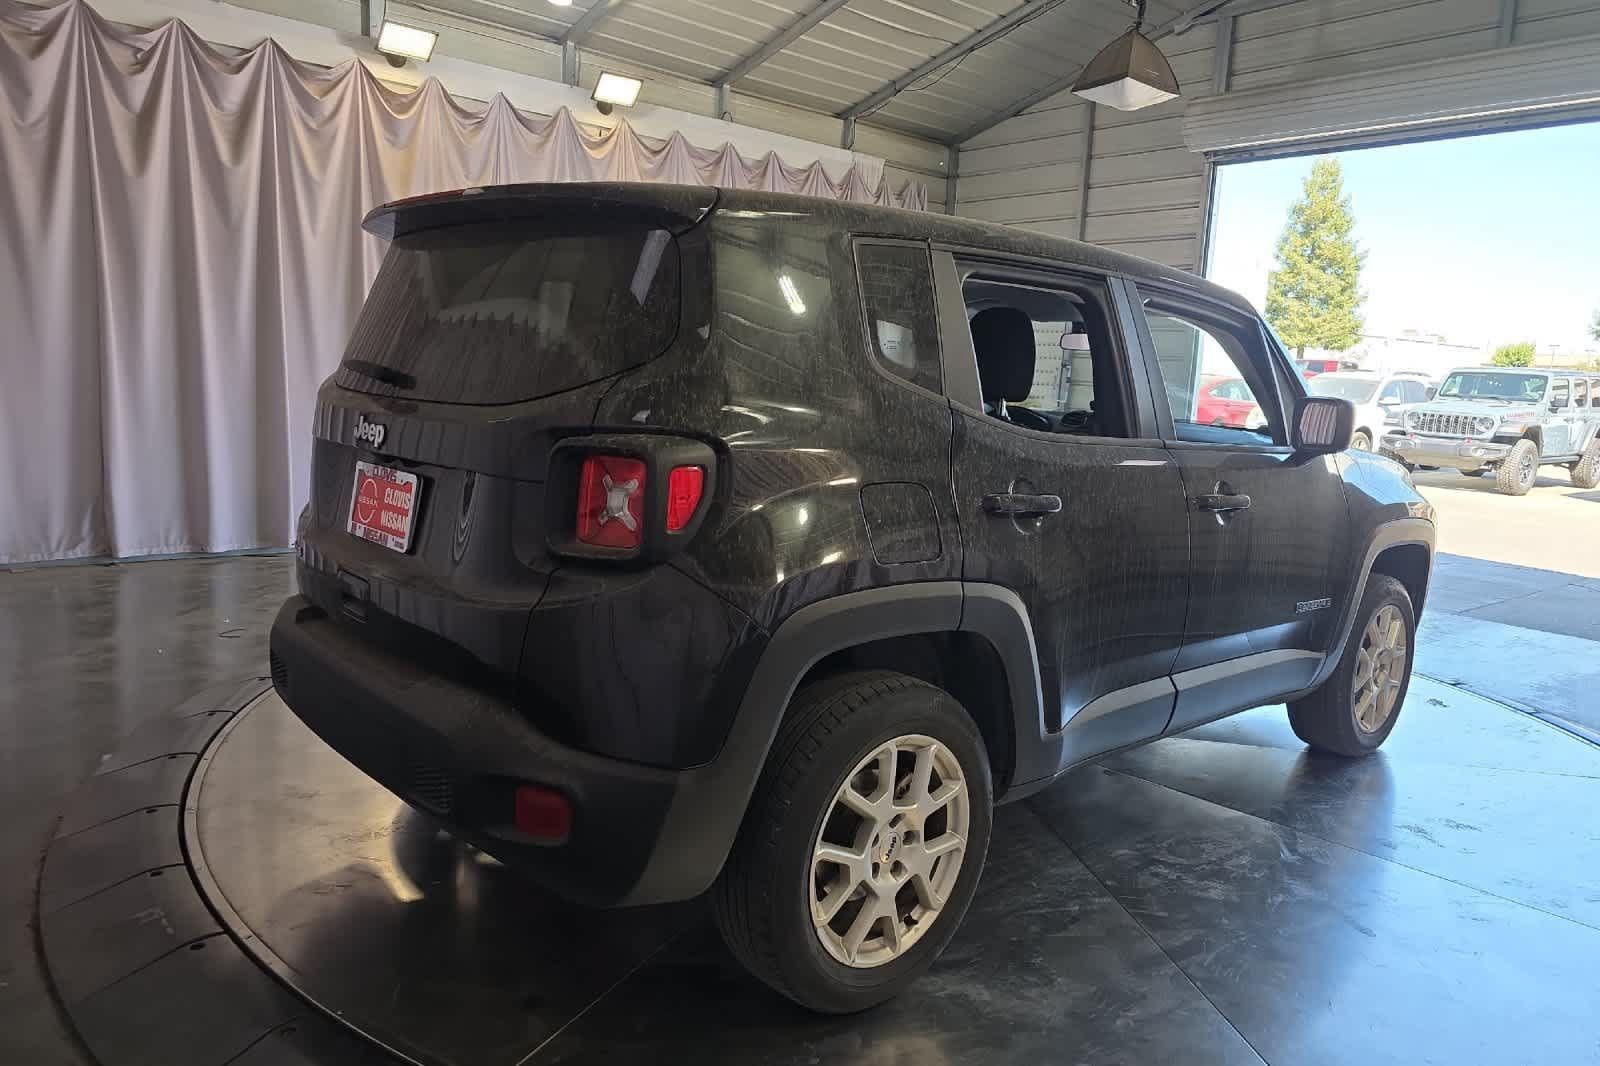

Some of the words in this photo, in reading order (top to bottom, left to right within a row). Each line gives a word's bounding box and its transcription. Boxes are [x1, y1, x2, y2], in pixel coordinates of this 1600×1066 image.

[354, 416, 385, 448] Jeep
[384, 487, 411, 510] CLOVIS
[381, 509, 409, 531] NISSAN
